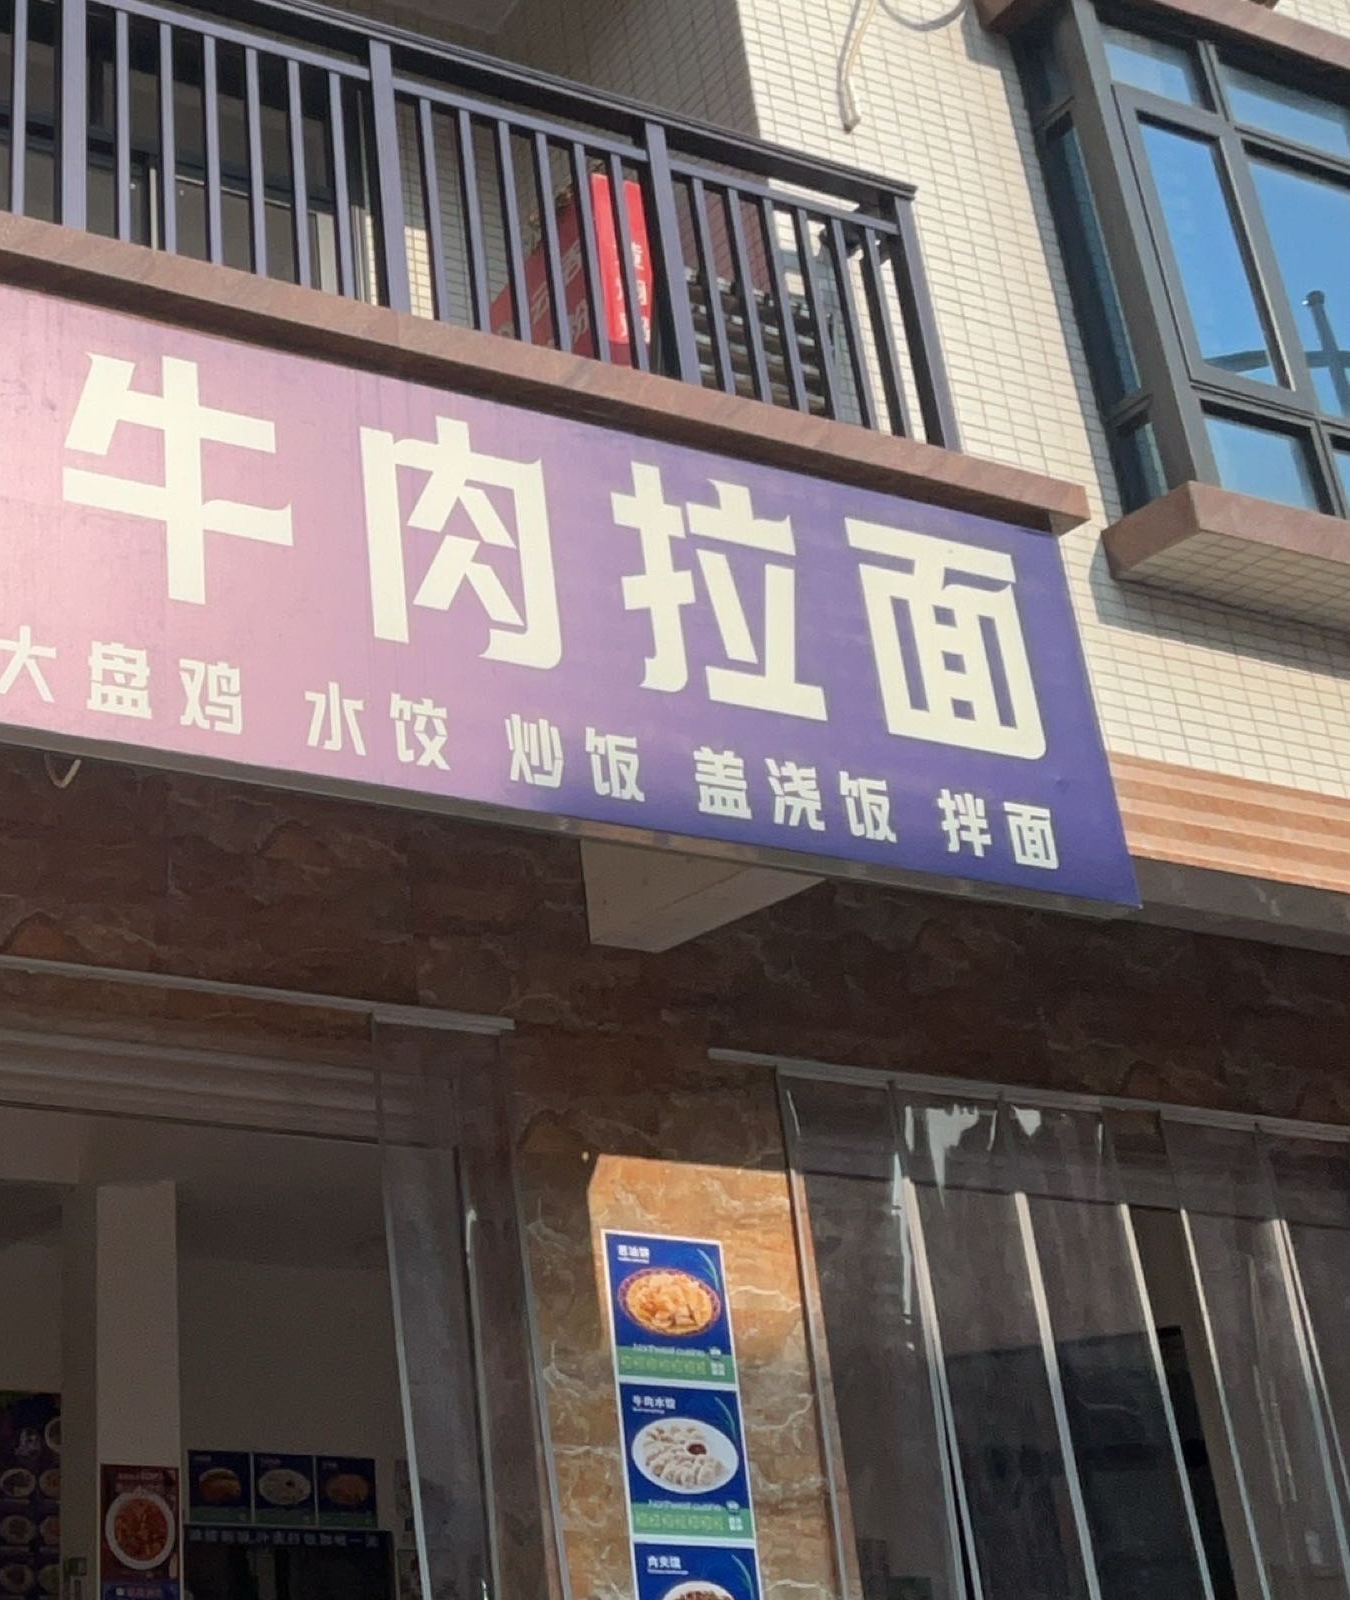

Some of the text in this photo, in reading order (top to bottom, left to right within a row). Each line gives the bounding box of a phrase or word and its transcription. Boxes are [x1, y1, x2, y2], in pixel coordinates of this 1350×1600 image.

[306, 681, 451, 771] 水饺
[507, 717, 645, 803] 炒饭
[692, 747, 897, 843] 盖浇饭
[939, 787, 1059, 870] 拌面
